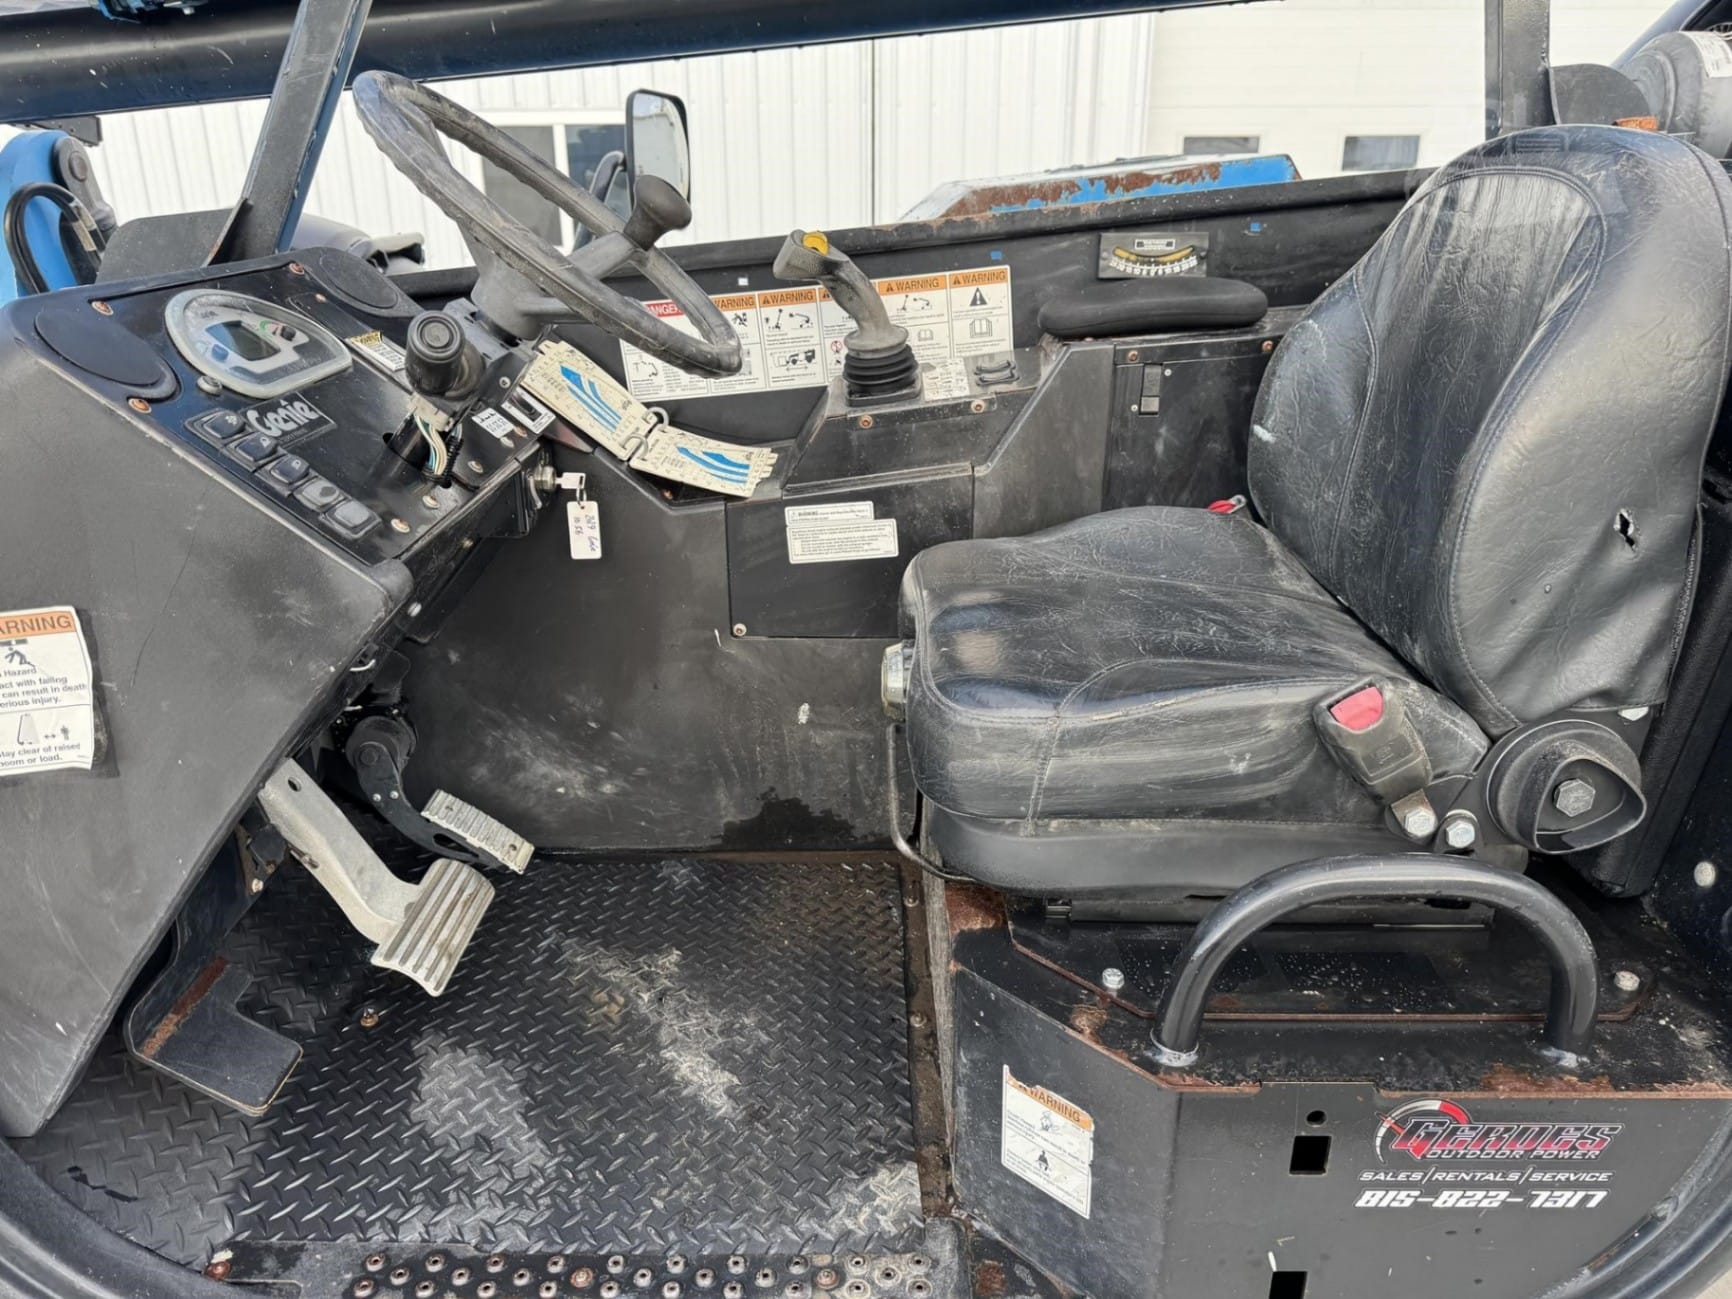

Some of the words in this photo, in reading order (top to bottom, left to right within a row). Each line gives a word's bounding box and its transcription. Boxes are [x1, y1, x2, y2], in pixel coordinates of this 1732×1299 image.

[894, 277, 940, 291] WARNING
[962, 270, 1006, 285] WARNING
[771, 290, 814, 304] WARNING
[246, 399, 320, 437] Genie
[3, 668, 37, 678] Hazard
[16, 679, 36, 688] with
[39, 677, 68, 685] falling
[22, 687, 48, 696] result
[51, 686, 60, 694] in
[62, 683, 86, 692] death
[18, 748, 40, 756] clear
[43, 745, 51, 753] of
[55, 742, 81, 752] raised
[1391, 1119, 1623, 1158] GERDES
[1426, 1150, 1524, 1160] OUTDOOR
[1528, 1150, 1602, 1160] POWER
[1354, 1189, 1609, 1209] 815-822-7317
